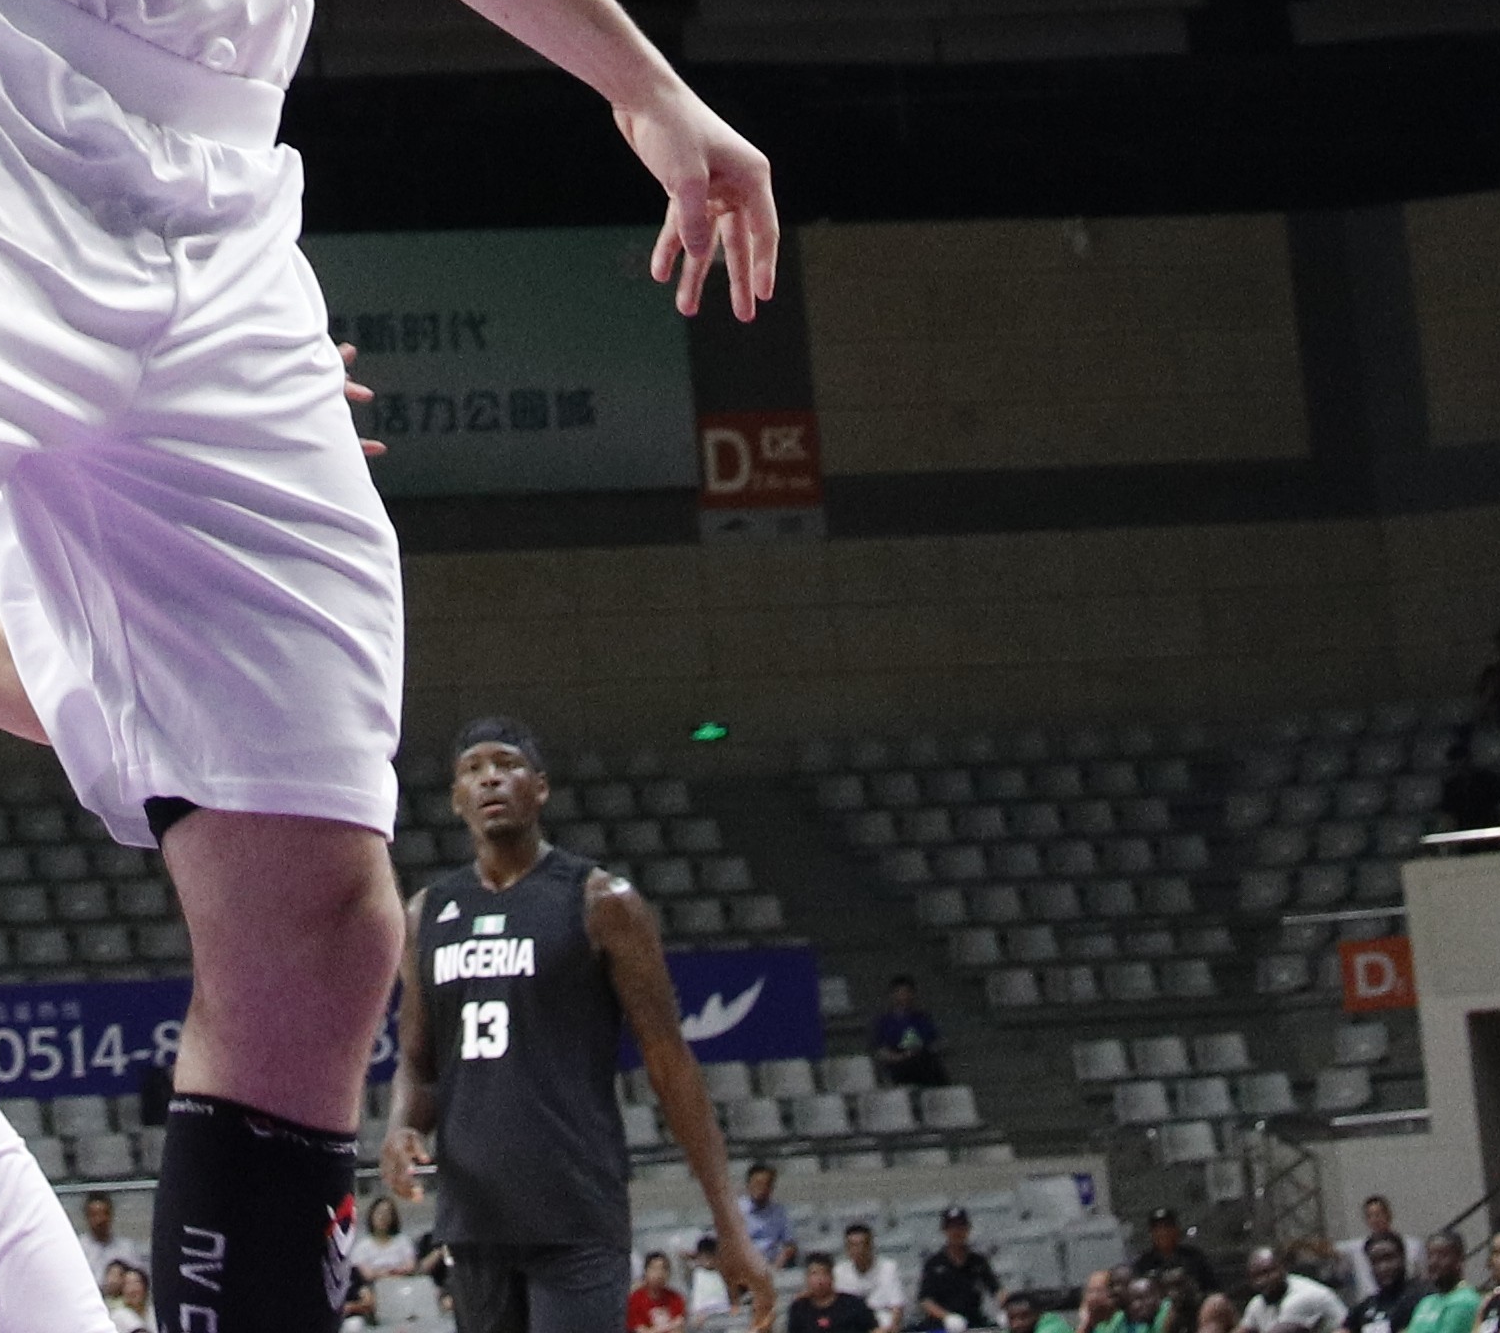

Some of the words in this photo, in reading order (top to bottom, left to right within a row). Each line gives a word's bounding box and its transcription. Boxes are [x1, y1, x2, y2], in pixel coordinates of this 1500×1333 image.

[330, 309, 488, 354] 新时代
[760, 425, 806, 460] 区
[434, 936, 535, 986] NIGERIA
[460, 999, 509, 1061] 13
